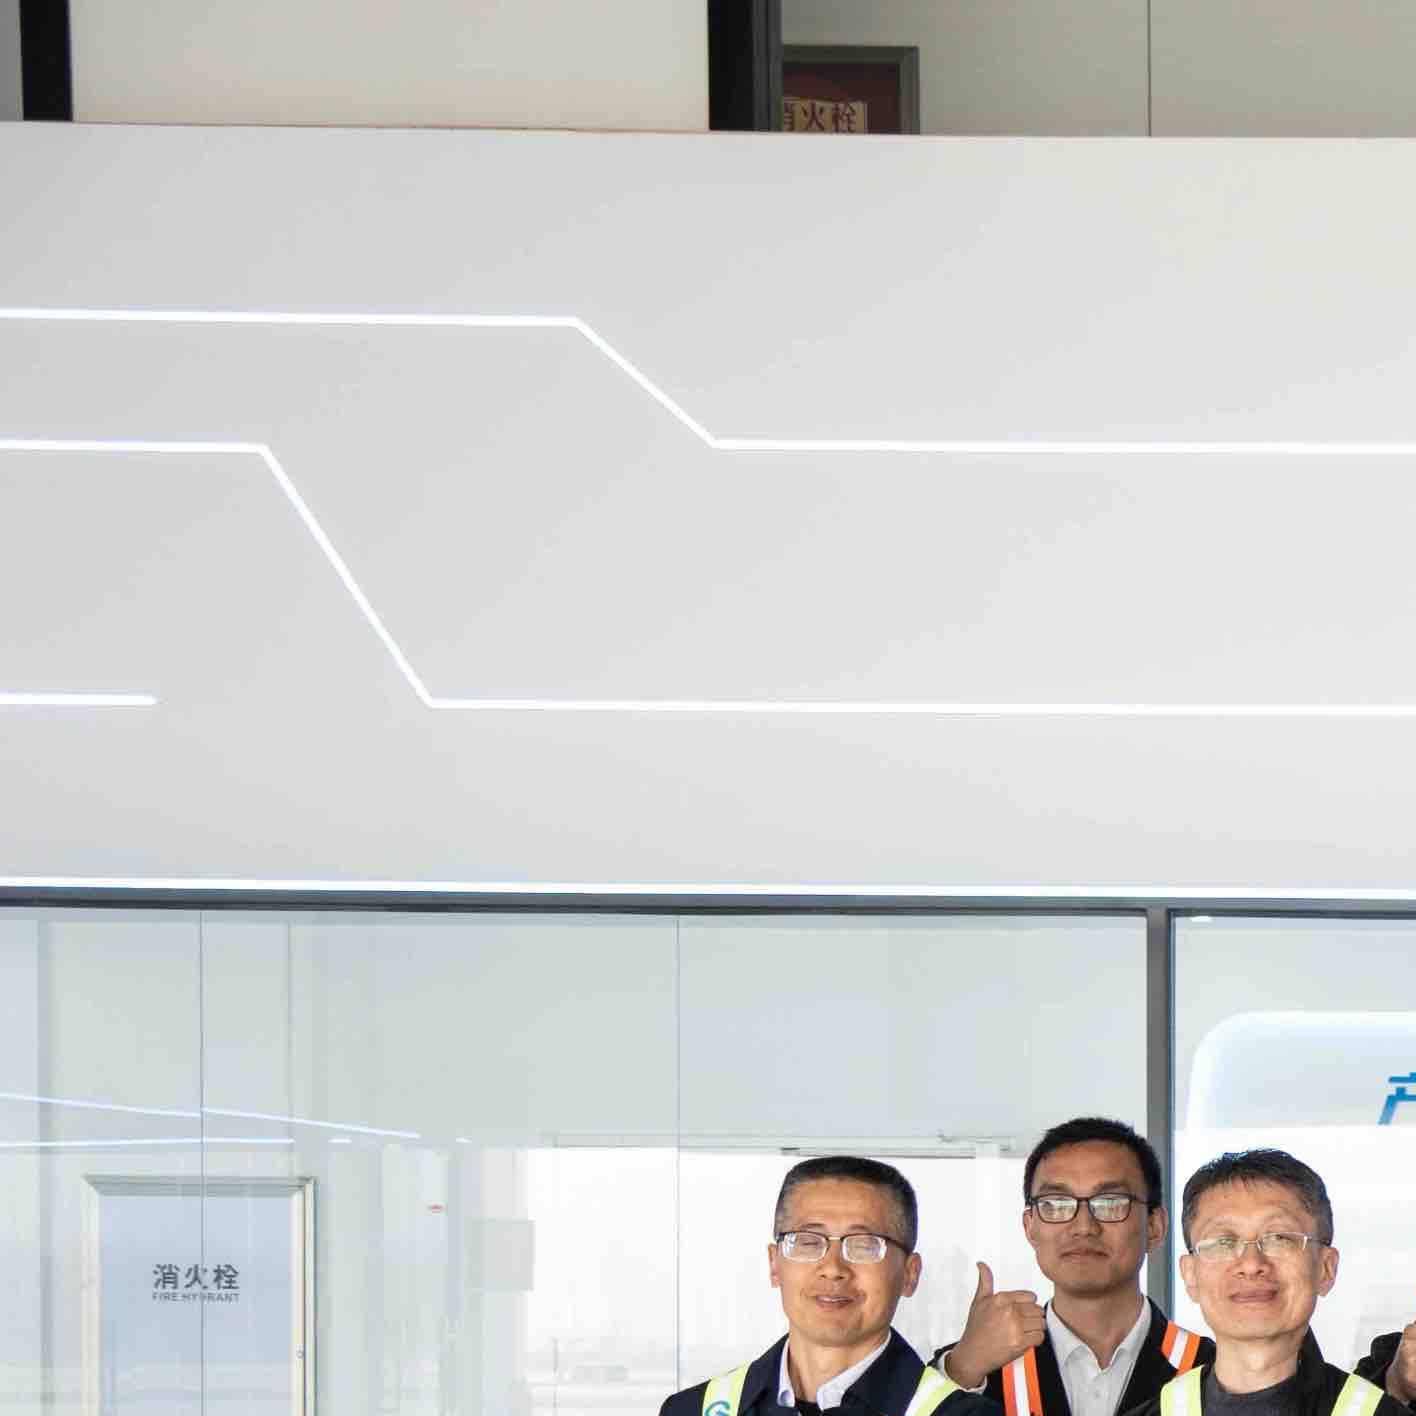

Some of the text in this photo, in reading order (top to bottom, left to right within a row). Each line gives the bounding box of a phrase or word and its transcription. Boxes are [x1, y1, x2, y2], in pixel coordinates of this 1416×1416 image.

[152, 1263, 241, 1290] 消火栓
[152, 1292, 240, 1303] FIRE HYDRANT
